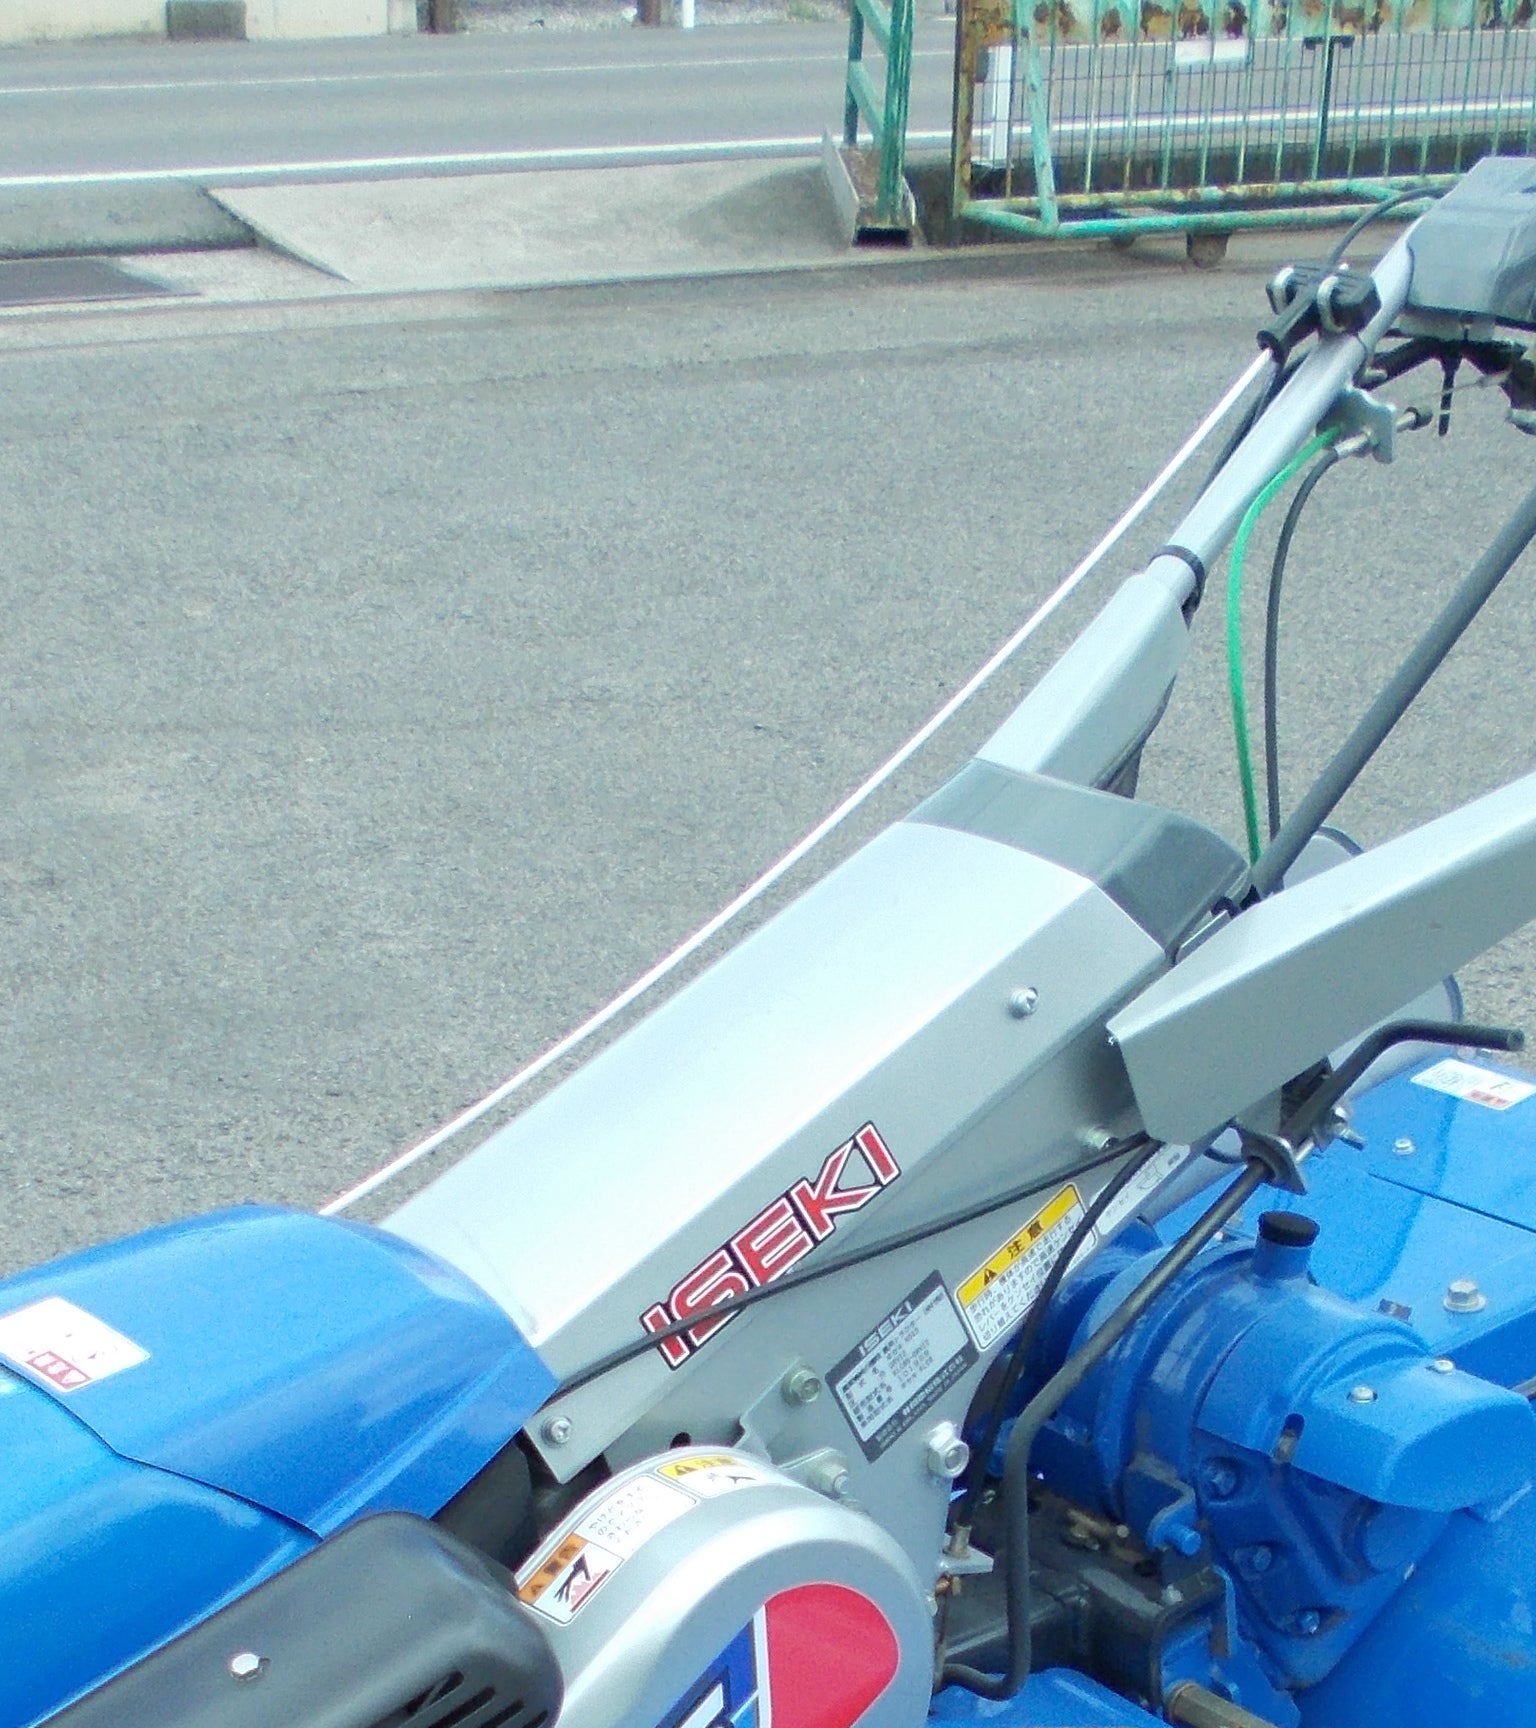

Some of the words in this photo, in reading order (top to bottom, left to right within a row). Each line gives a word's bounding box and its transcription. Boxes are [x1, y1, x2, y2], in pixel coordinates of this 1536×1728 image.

[640, 1121, 902, 1371] ISEKI
[1005, 1218, 1044, 1260] 注意
[857, 1300, 913, 1357] ISEKI
